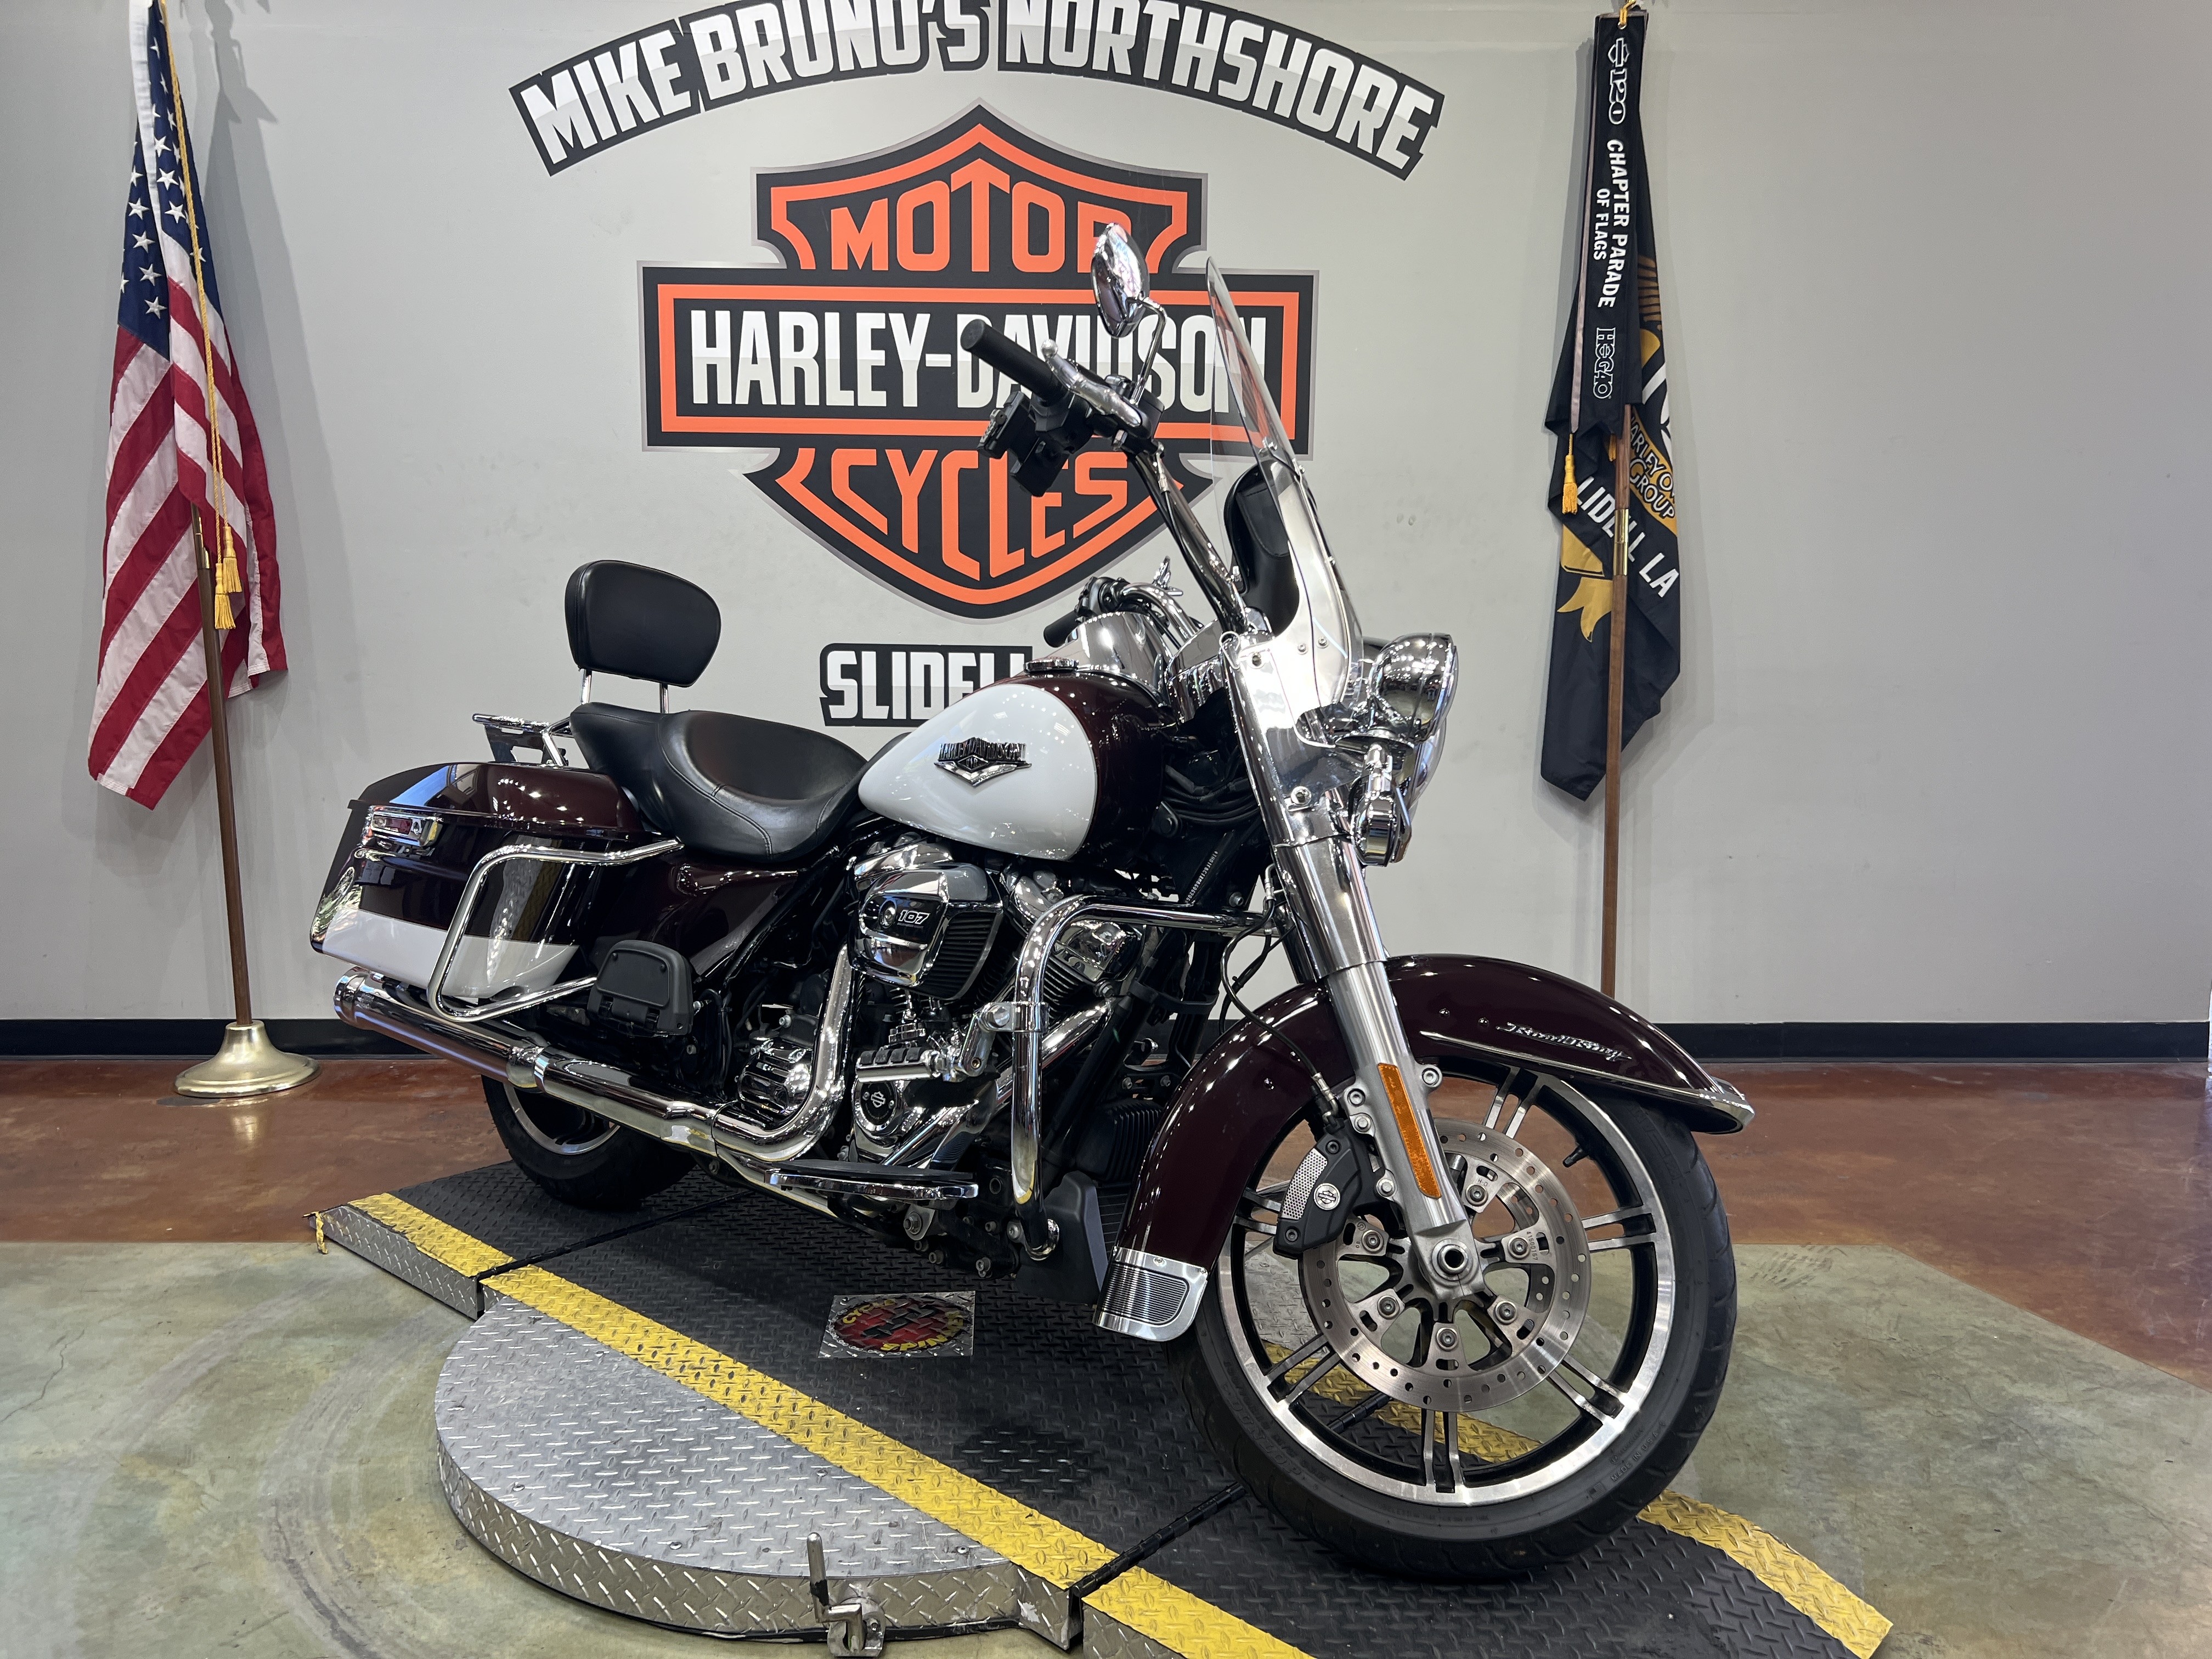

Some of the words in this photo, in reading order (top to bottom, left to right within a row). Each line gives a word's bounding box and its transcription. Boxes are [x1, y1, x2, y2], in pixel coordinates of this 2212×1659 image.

[520, 29, 693, 165] MIKE
[689, 0, 981, 100] BRUNO'S
[1006, 0, 1436, 169] NORTHSHORE
[1596, 188, 1611, 208] OF
[1606, 139, 1629, 228] CHAPTER
[831, 157, 1132, 271] MOTOR
[1593, 212, 1610, 261] FLAGS
[1598, 233, 1629, 308] PARADE
[831, 448, 1128, 582] CYCLES
[1630, 458, 1675, 518] GROUP
[1639, 552, 1679, 598] LA
[898, 909, 931, 925] 107
[1477, 1178, 1488, 1187] H-D
